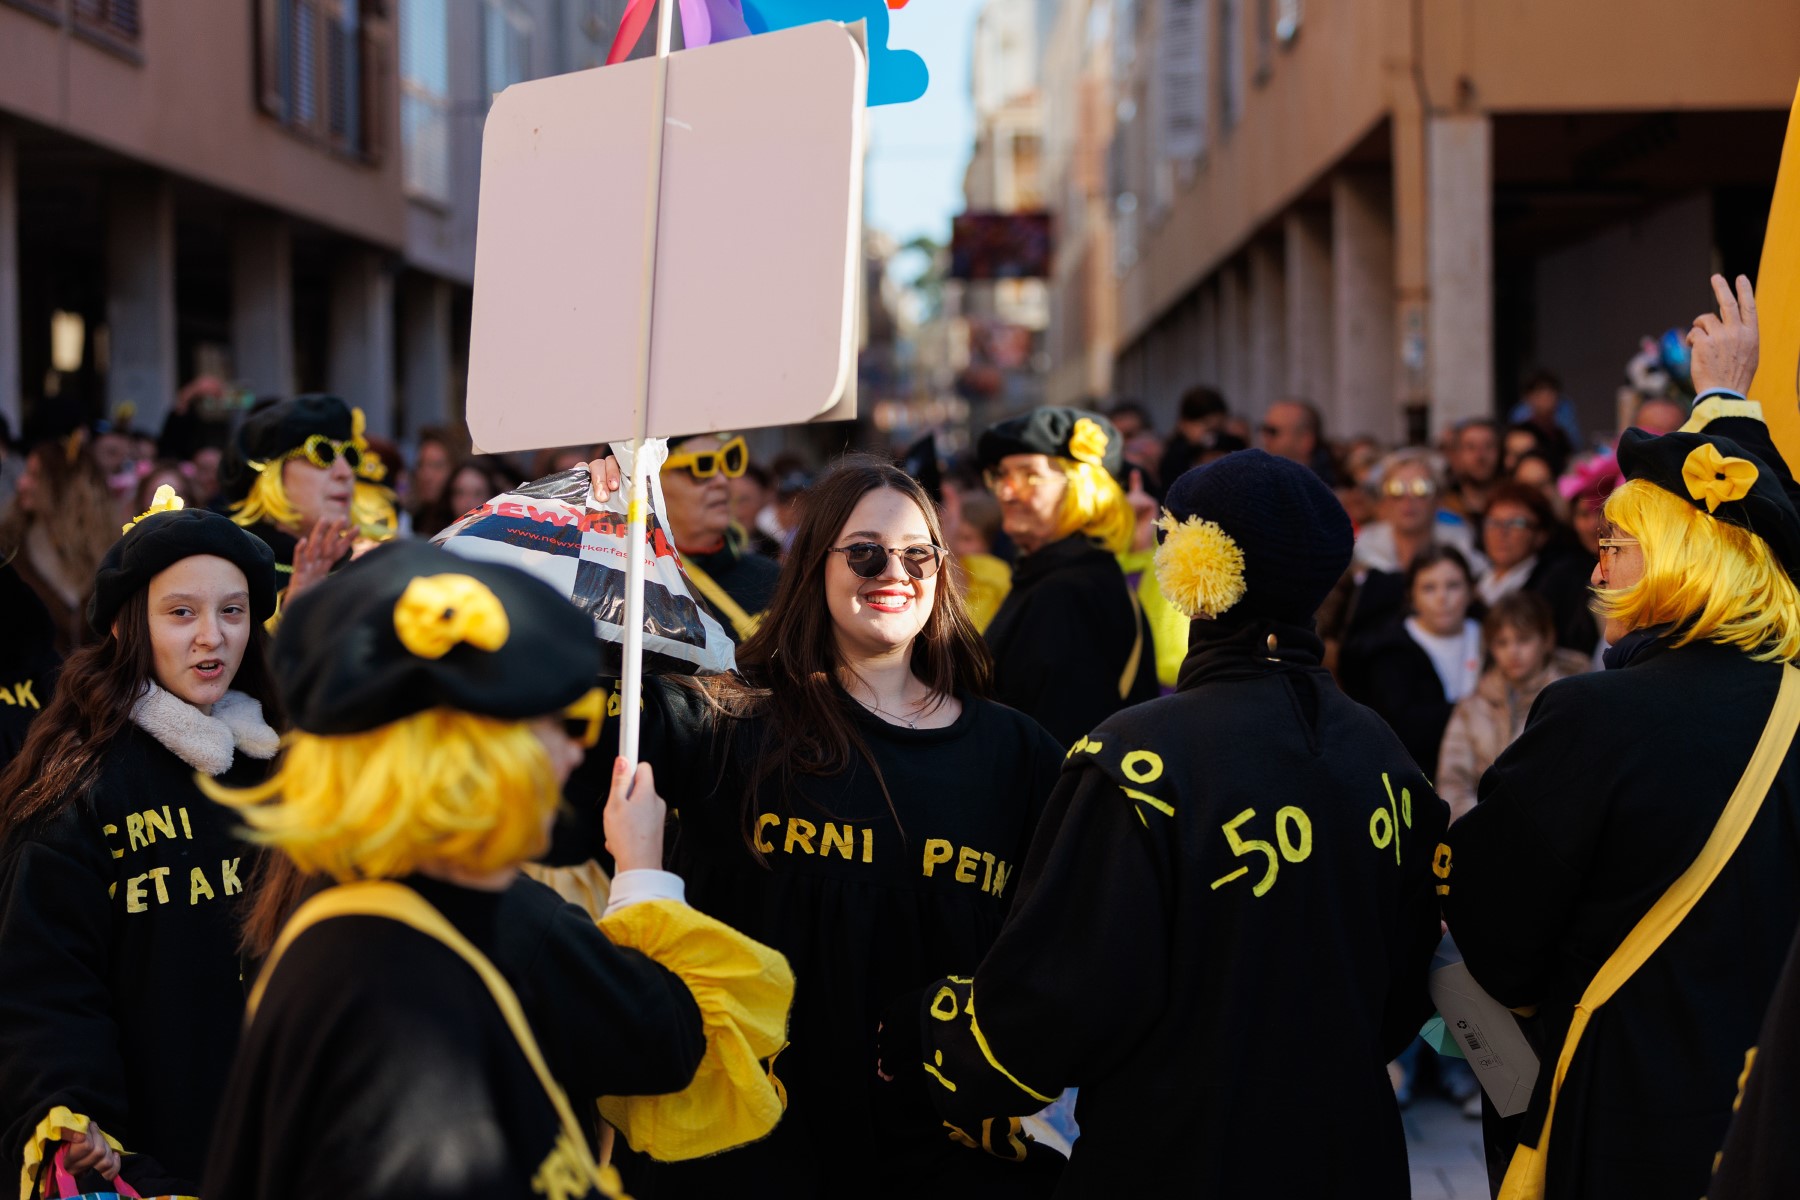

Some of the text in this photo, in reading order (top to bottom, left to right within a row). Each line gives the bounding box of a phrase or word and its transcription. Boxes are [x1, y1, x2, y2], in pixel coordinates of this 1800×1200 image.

[507, 528, 655, 567] www.newyorker.fasn
[753, 812, 873, 863] CRNI
[108, 857, 243, 914] ETAK
